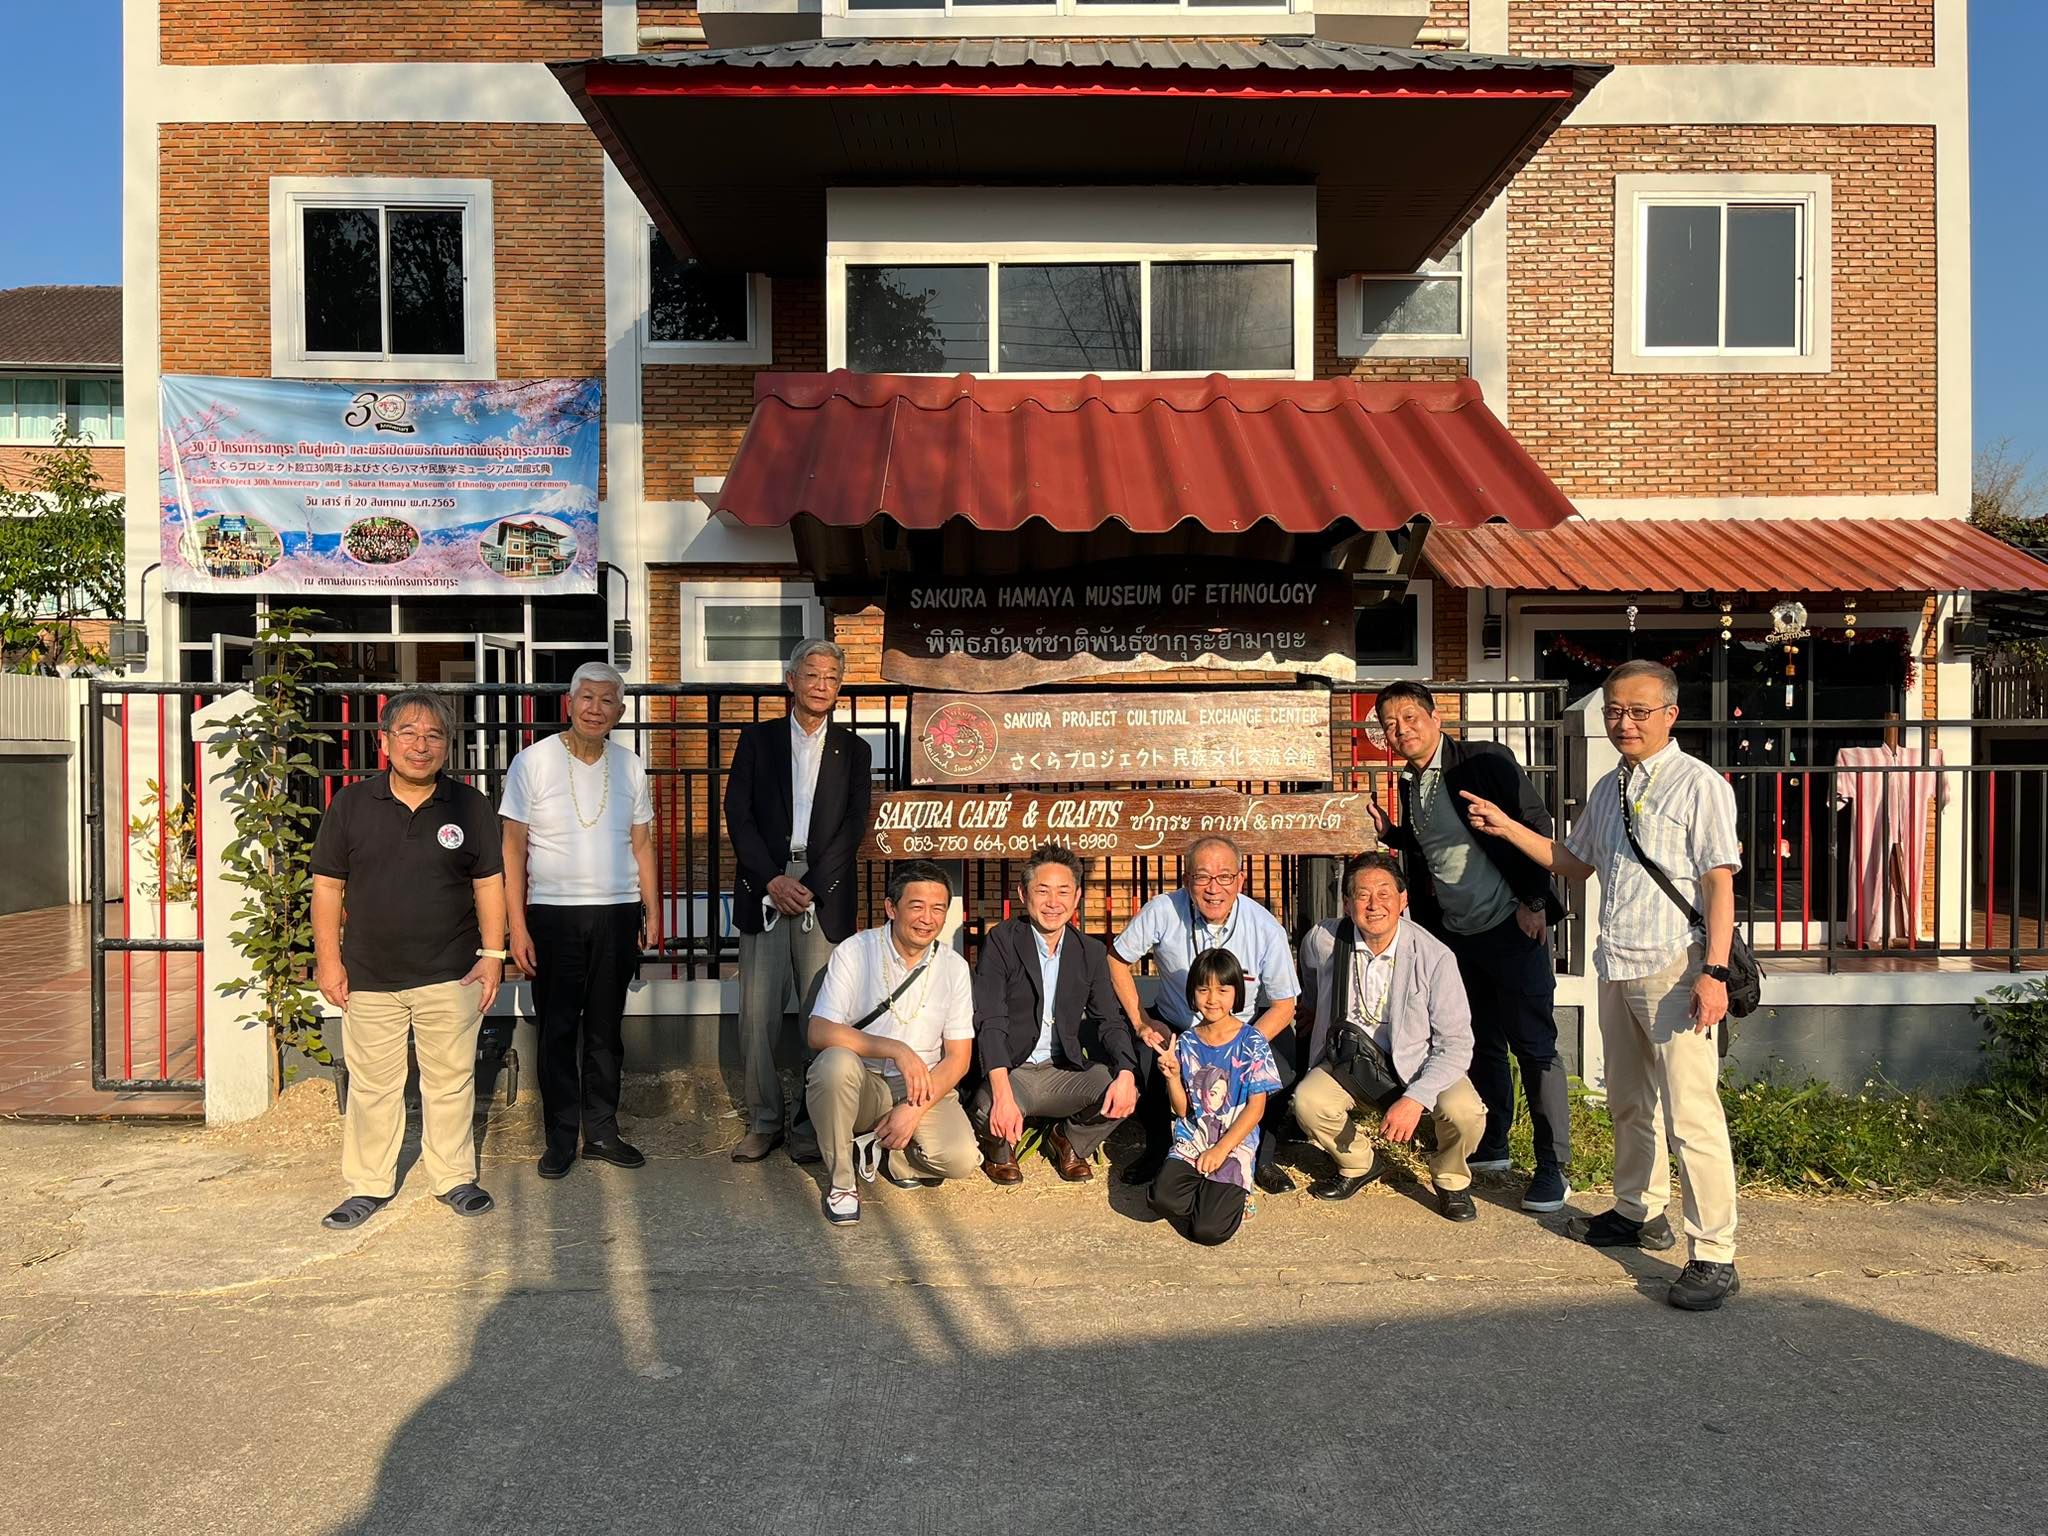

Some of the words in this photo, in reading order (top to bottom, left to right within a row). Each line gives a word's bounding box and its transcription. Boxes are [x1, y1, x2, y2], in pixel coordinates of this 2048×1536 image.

[380, 424, 409, 432] Anniversary
[190, 442, 204, 453] 30
[192, 476, 220, 485] Sakura
[222, 476, 251, 487] Project
[253, 477, 270, 486] 30th
[272, 478, 320, 488] Anniversary
[325, 479, 340, 487] and
[348, 479, 376, 487] Sakura
[378, 480, 411, 490] Hamaya
[412, 481, 445, 489] Museum
[447, 480, 455, 489] of
[457, 480, 496, 491] Ethnology
[498, 480, 528, 491] opening
[530, 481, 568, 491] ceremony
[355, 497, 367, 507] 20
[910, 588, 987, 608] SAKURA
[998, 586, 1075, 608] HAMAYA
[1085, 585, 1161, 606] MUSEUM
[1171, 584, 1197, 605] OF
[1206, 583, 1317, 605] ETHNOLOGY
[1003, 711, 1052, 729] SAKURA
[1062, 710, 1118, 728] PROJECT
[1126, 709, 1190, 727] CULTURAL
[1199, 708, 1263, 726] EXCHANGE
[1270, 707, 1319, 725] CENTER
[1009, 748, 1164, 771] さくらプロジェクト
[1172, 746, 1317, 768] 民族文化交流会館
[874, 800, 953, 829] SAKURA
[958, 793, 1013, 829] CAFÉ
[1022, 800, 1040, 828] &
[1047, 800, 1124, 828] CRAFTS
[1129, 798, 1192, 850] ซากุระ
[903, 835, 968, 852] 053-750
